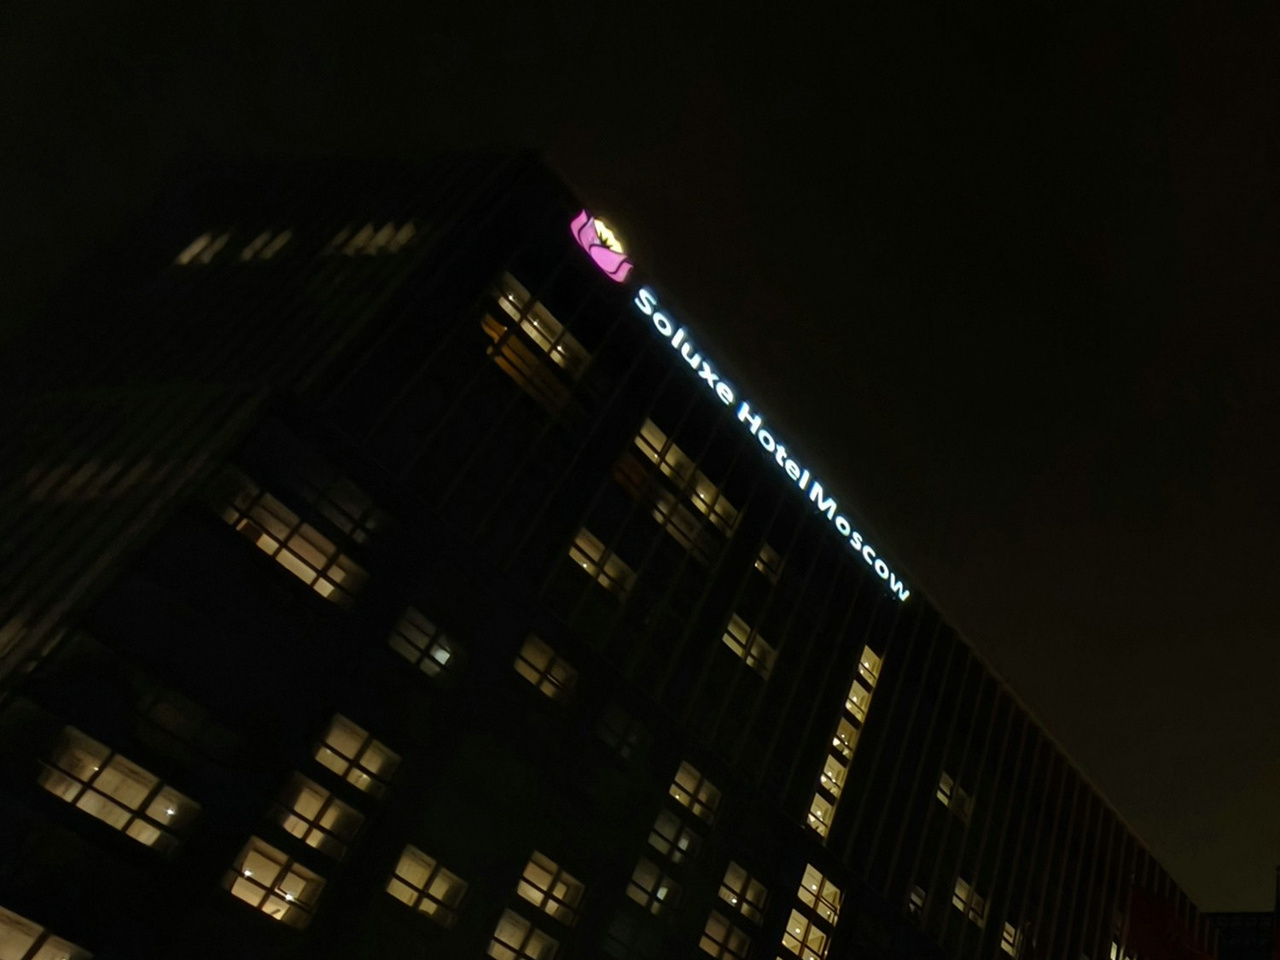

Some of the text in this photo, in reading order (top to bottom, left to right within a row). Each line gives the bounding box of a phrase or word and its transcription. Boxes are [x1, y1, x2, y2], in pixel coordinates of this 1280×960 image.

[635, 288, 910, 602] Soluxe Hotel Moscow
